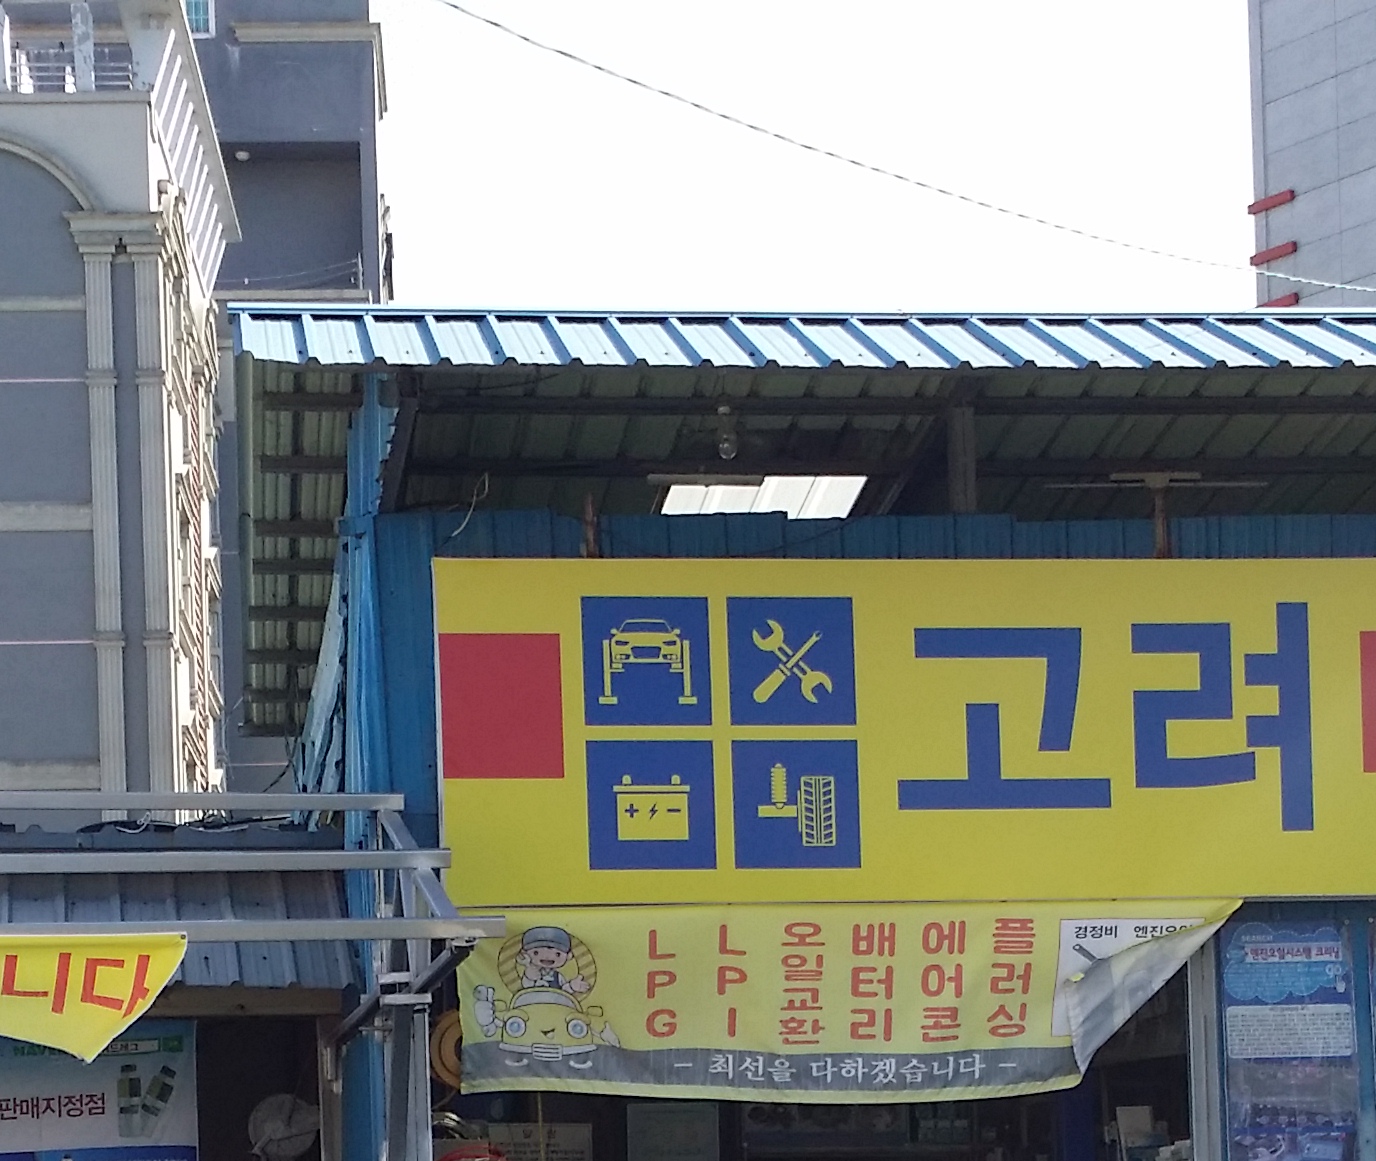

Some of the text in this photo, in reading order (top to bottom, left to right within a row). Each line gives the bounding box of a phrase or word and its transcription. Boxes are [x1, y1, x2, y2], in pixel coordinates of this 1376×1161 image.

[898, 602, 1314, 831] 고려
[1074, 925, 1118, 939] 경정비
[708, 1053, 986, 1084] 최선을 다하겠습니다
